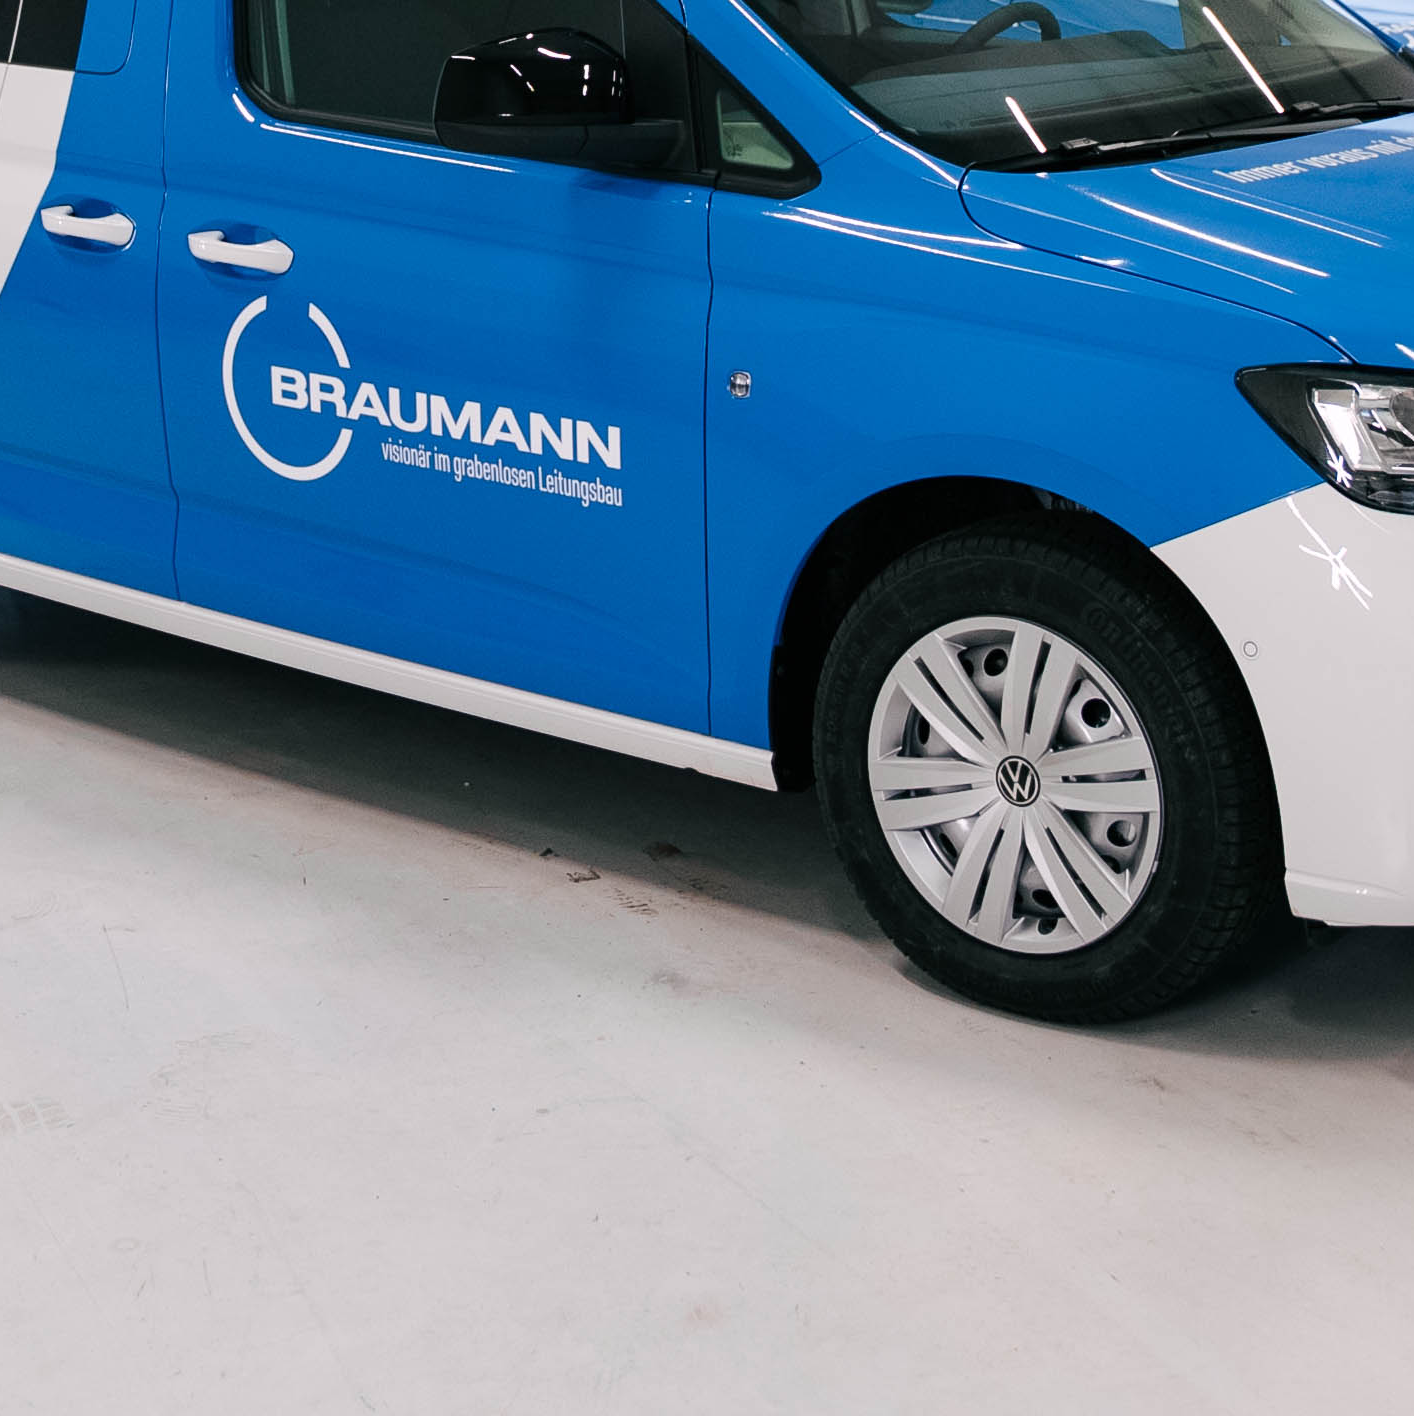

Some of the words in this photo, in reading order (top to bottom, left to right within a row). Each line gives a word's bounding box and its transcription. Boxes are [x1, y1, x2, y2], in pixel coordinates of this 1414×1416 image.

[1212, 159, 1309, 184] Immer
[1296, 147, 1380, 169] voraus
[271, 365, 621, 470] BRAUMANN
[381, 438, 431, 469] visionär
[434, 447, 451, 473] im
[454, 454, 536, 490] grabenlosen
[538, 466, 623, 508] Leitungsbau
